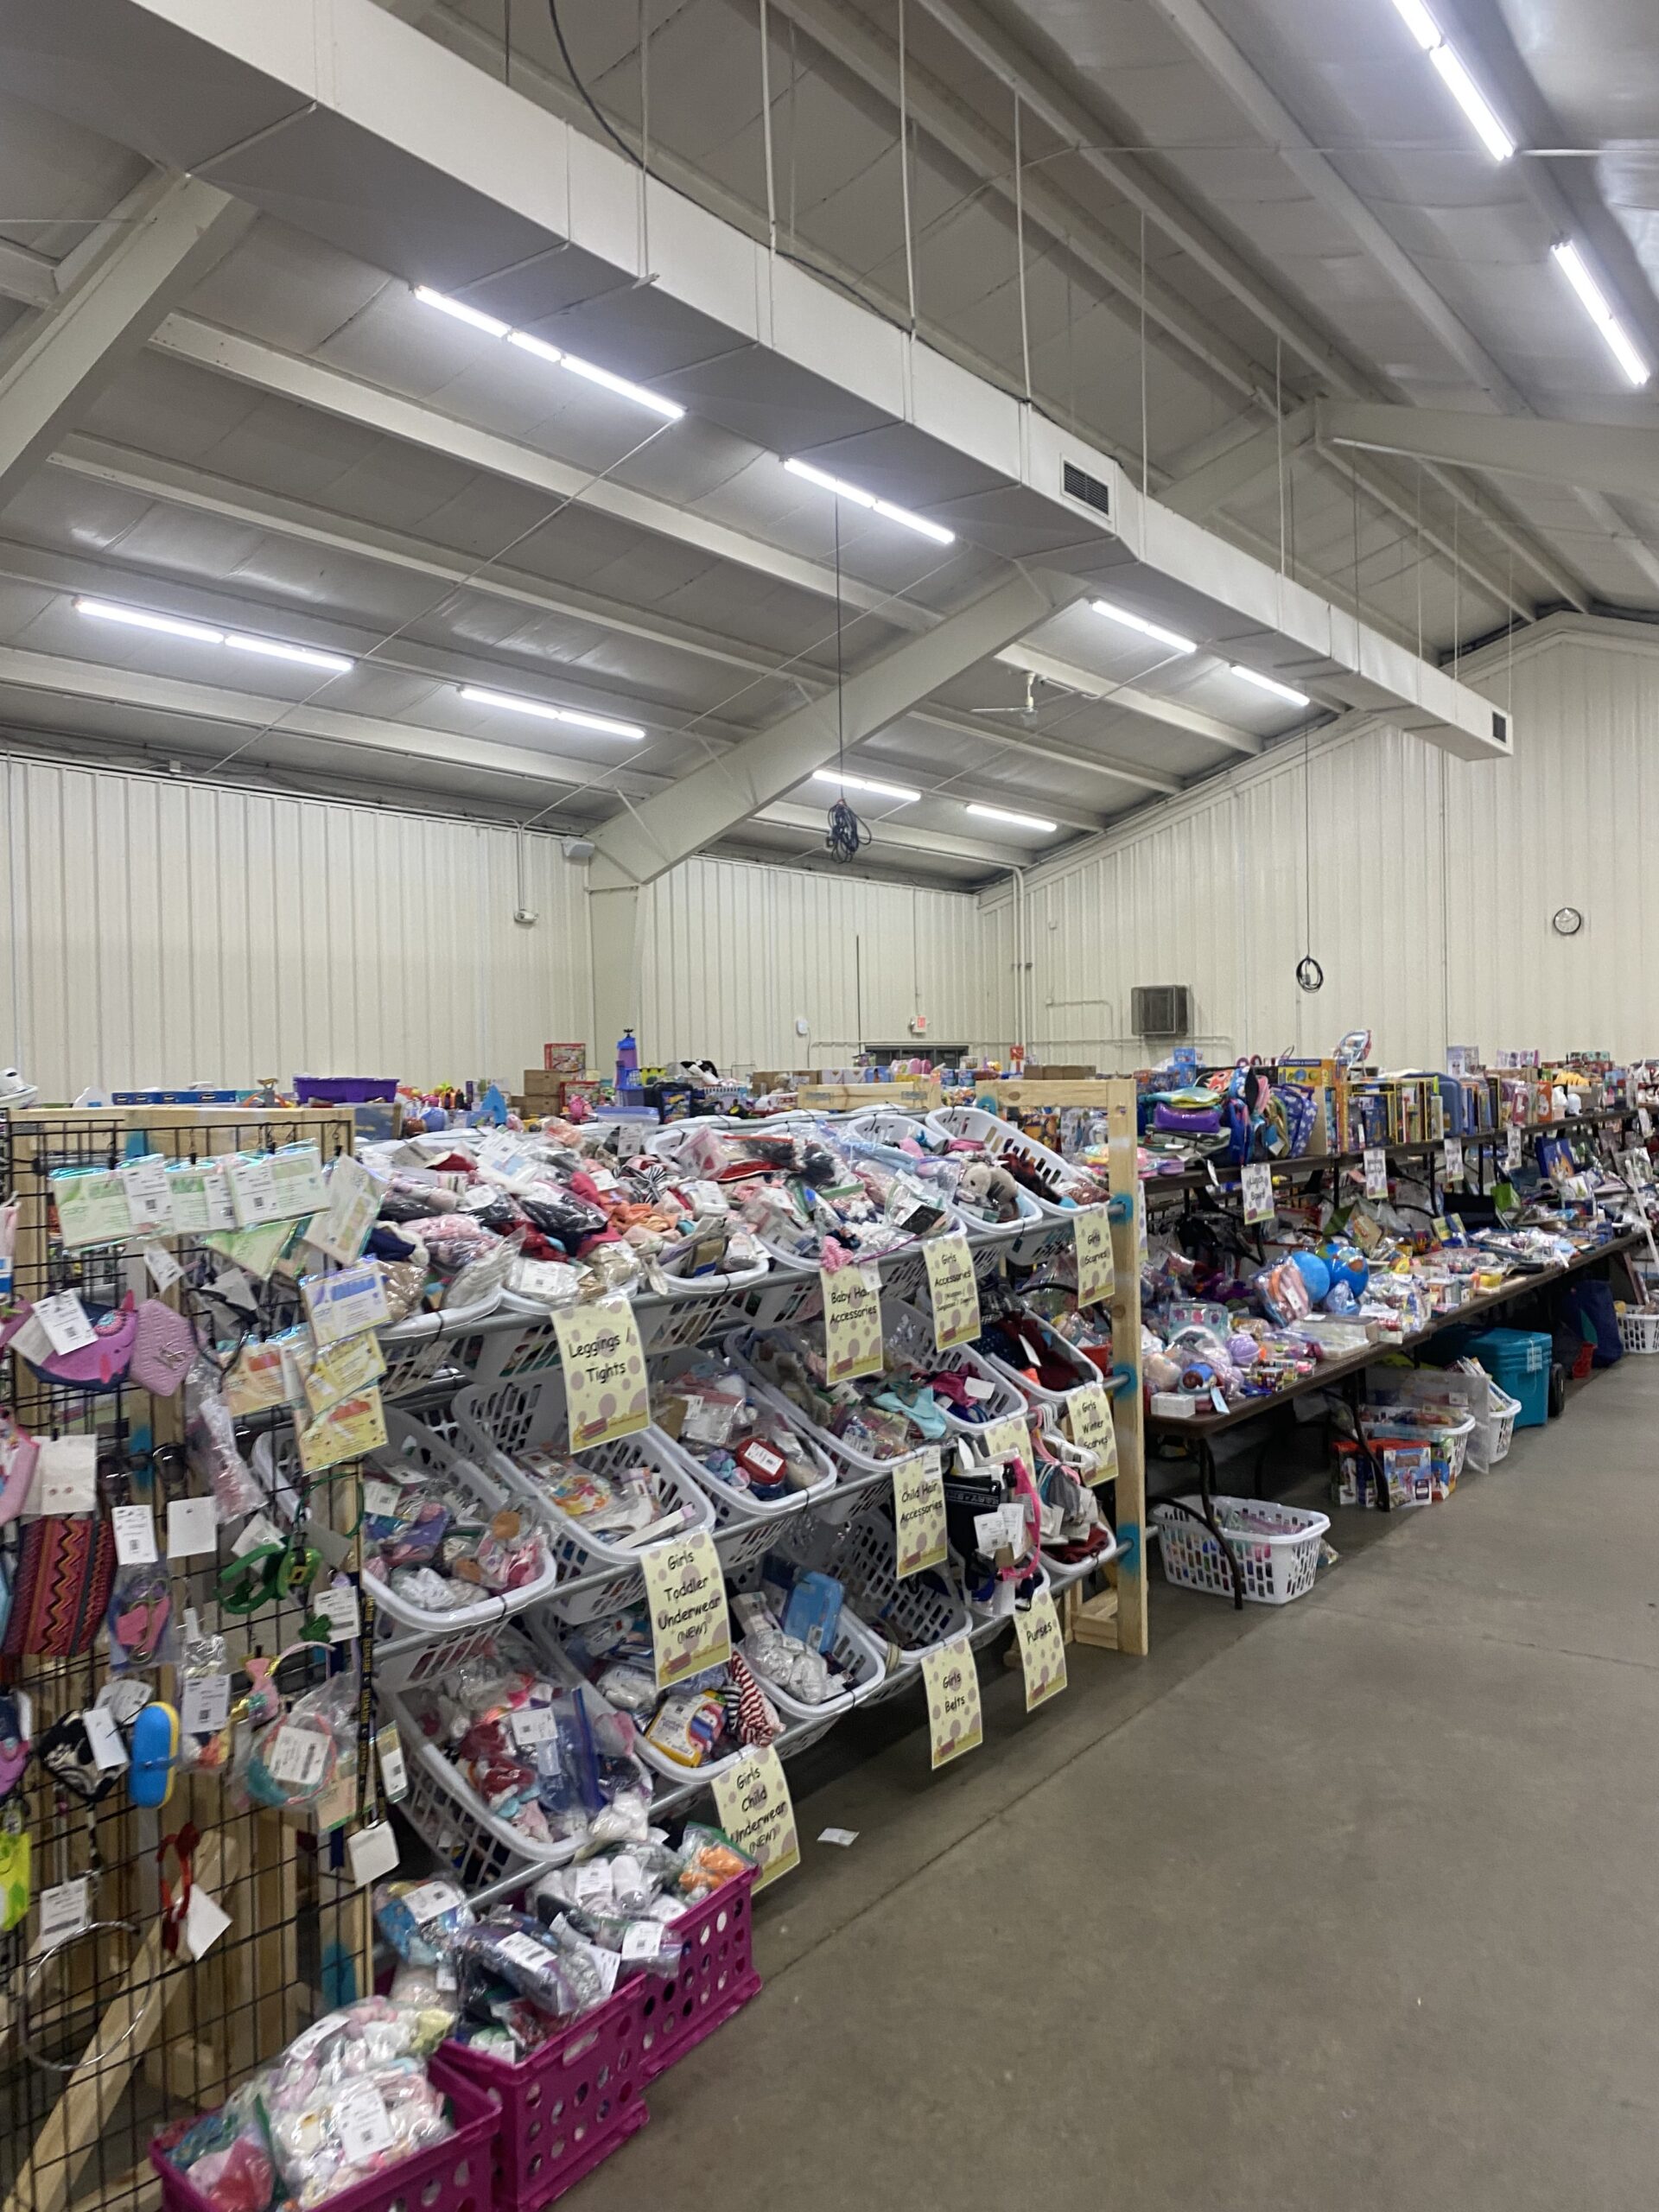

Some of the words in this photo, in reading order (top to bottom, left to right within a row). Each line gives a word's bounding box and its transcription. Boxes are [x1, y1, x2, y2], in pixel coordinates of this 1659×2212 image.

[941, 1253, 957, 1265] Girls
[935, 1269, 972, 1287] Accessories
[831, 1290, 851, 1304] Baby
[854, 1287, 870, 1299] Ha
[830, 1305, 877, 1325] Accessories
[569, 1335, 620, 1358] Leggings
[586, 1363, 626, 1383] Tights
[1082, 1401, 1096, 1413] Girls
[1083, 1421, 1103, 1433] Winter
[1084, 1436, 1108, 1449] Scarves
[901, 1487, 920, 1503] Child
[922, 1481, 938, 1495] Hair
[900, 1500, 943, 1523] Accessories
[668, 1550, 695, 1570] Girls
[664, 1576, 709, 1601] Toddler
[658, 1597, 721, 1630] Underwear
[677, 1621, 708, 1644] (NEW)
[1027, 1621, 1052, 1645] Purses
[943, 1672, 962, 1688] Girls
[945, 1695, 965, 1713] Belts
[737, 1765, 760, 1789] Girls
[741, 1784, 767, 1812] Child
[730, 1801, 786, 1843] Underwear
[749, 1828, 776, 1854] (NEW)
